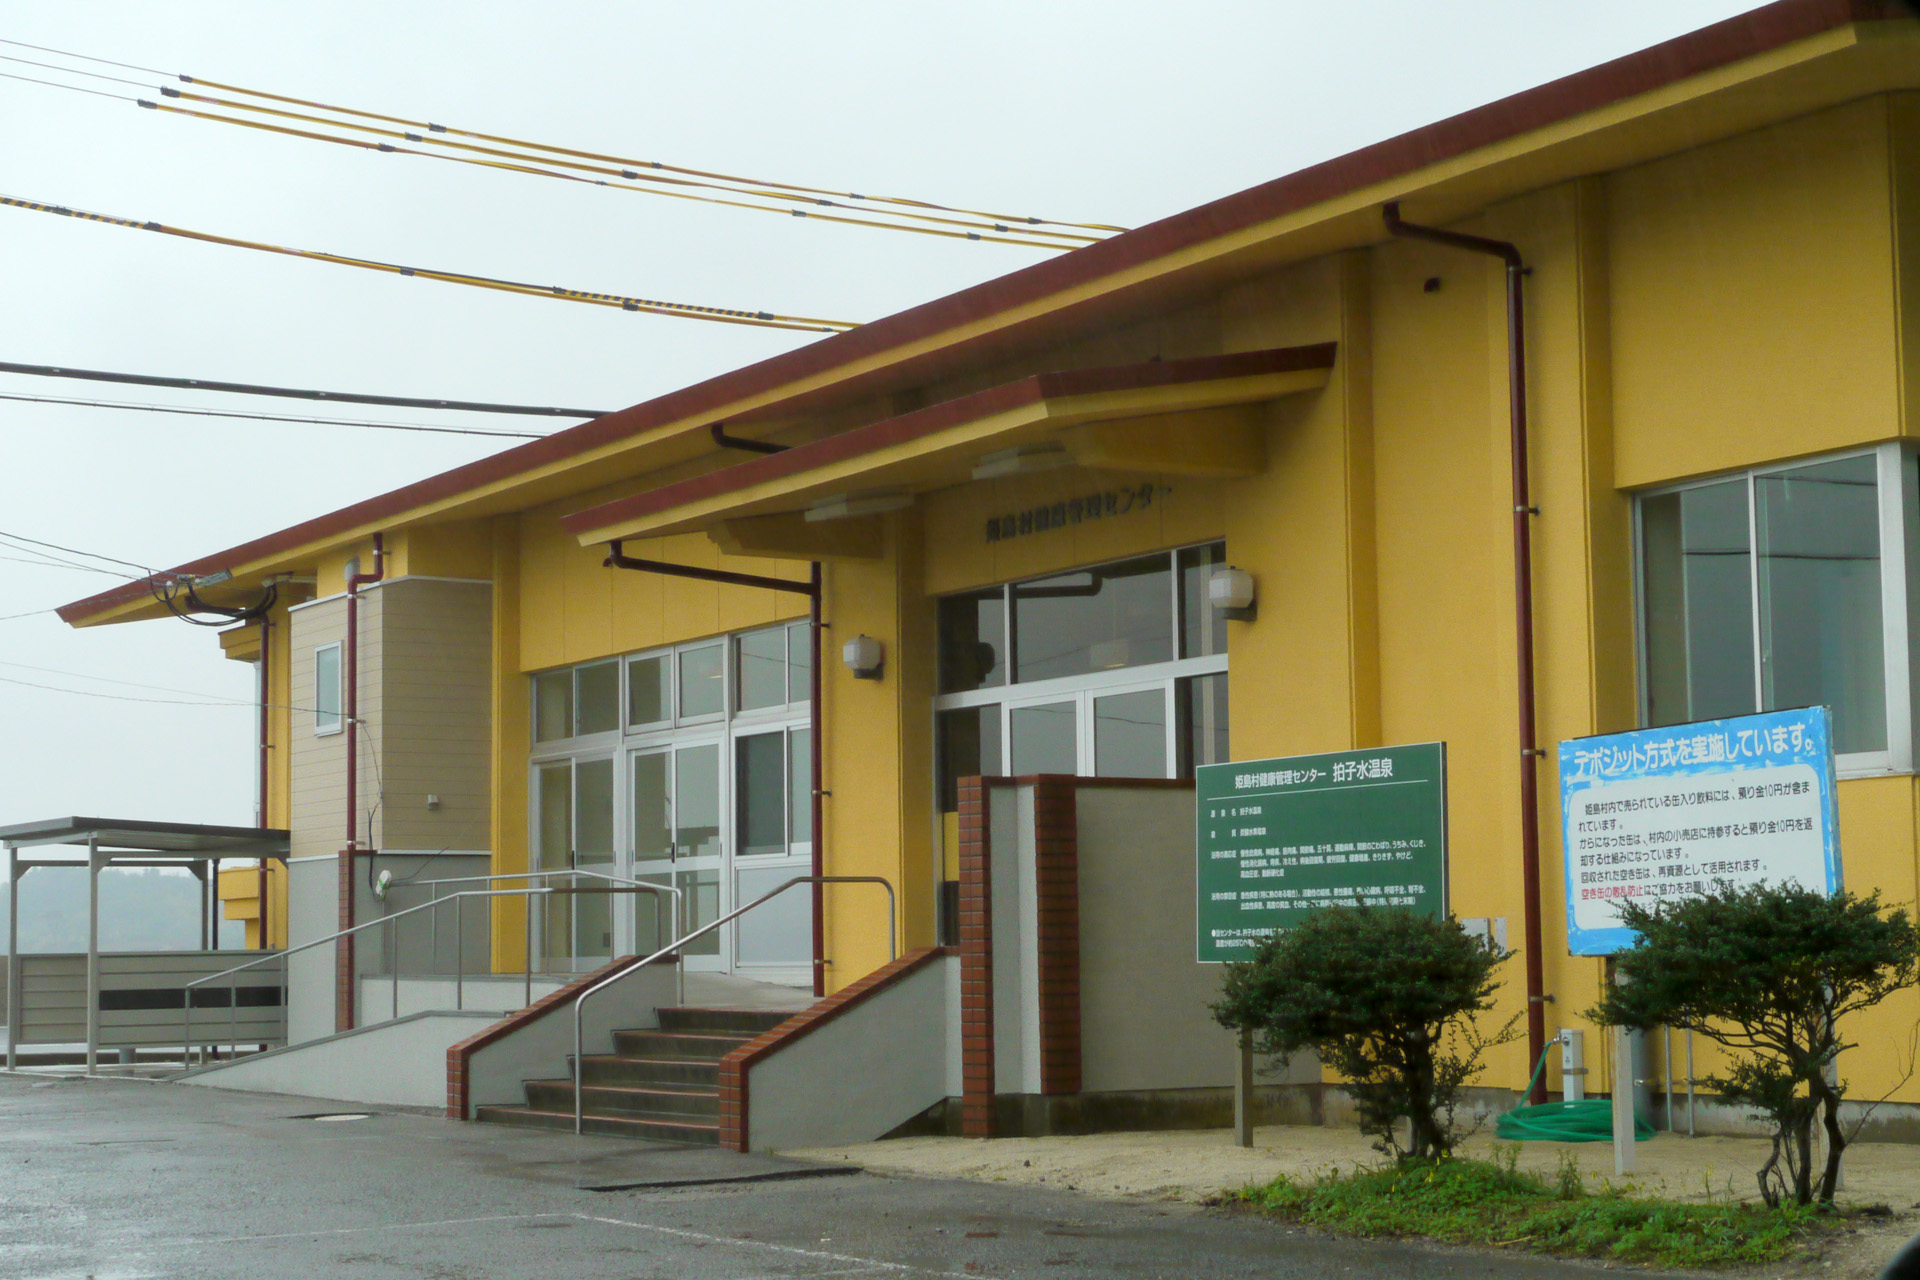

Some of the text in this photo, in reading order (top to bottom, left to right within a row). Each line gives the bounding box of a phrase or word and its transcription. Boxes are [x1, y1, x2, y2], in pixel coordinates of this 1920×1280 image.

[1574, 722, 1813, 775] デポジット方式を実施しています。
[1235, 758, 1393, 789] 姫島村健康管理センター 拍子水温泉
[1585, 781, 1810, 816] 姫島村内で売られている缶入り飲料には、預り金10円が含ま
[1578, 818, 1623, 832] れています。
[1580, 847, 1689, 867] 却する仕組みになっています。
[1581, 859, 1768, 884] 回収された空き缶は、再資源として活用されます。
